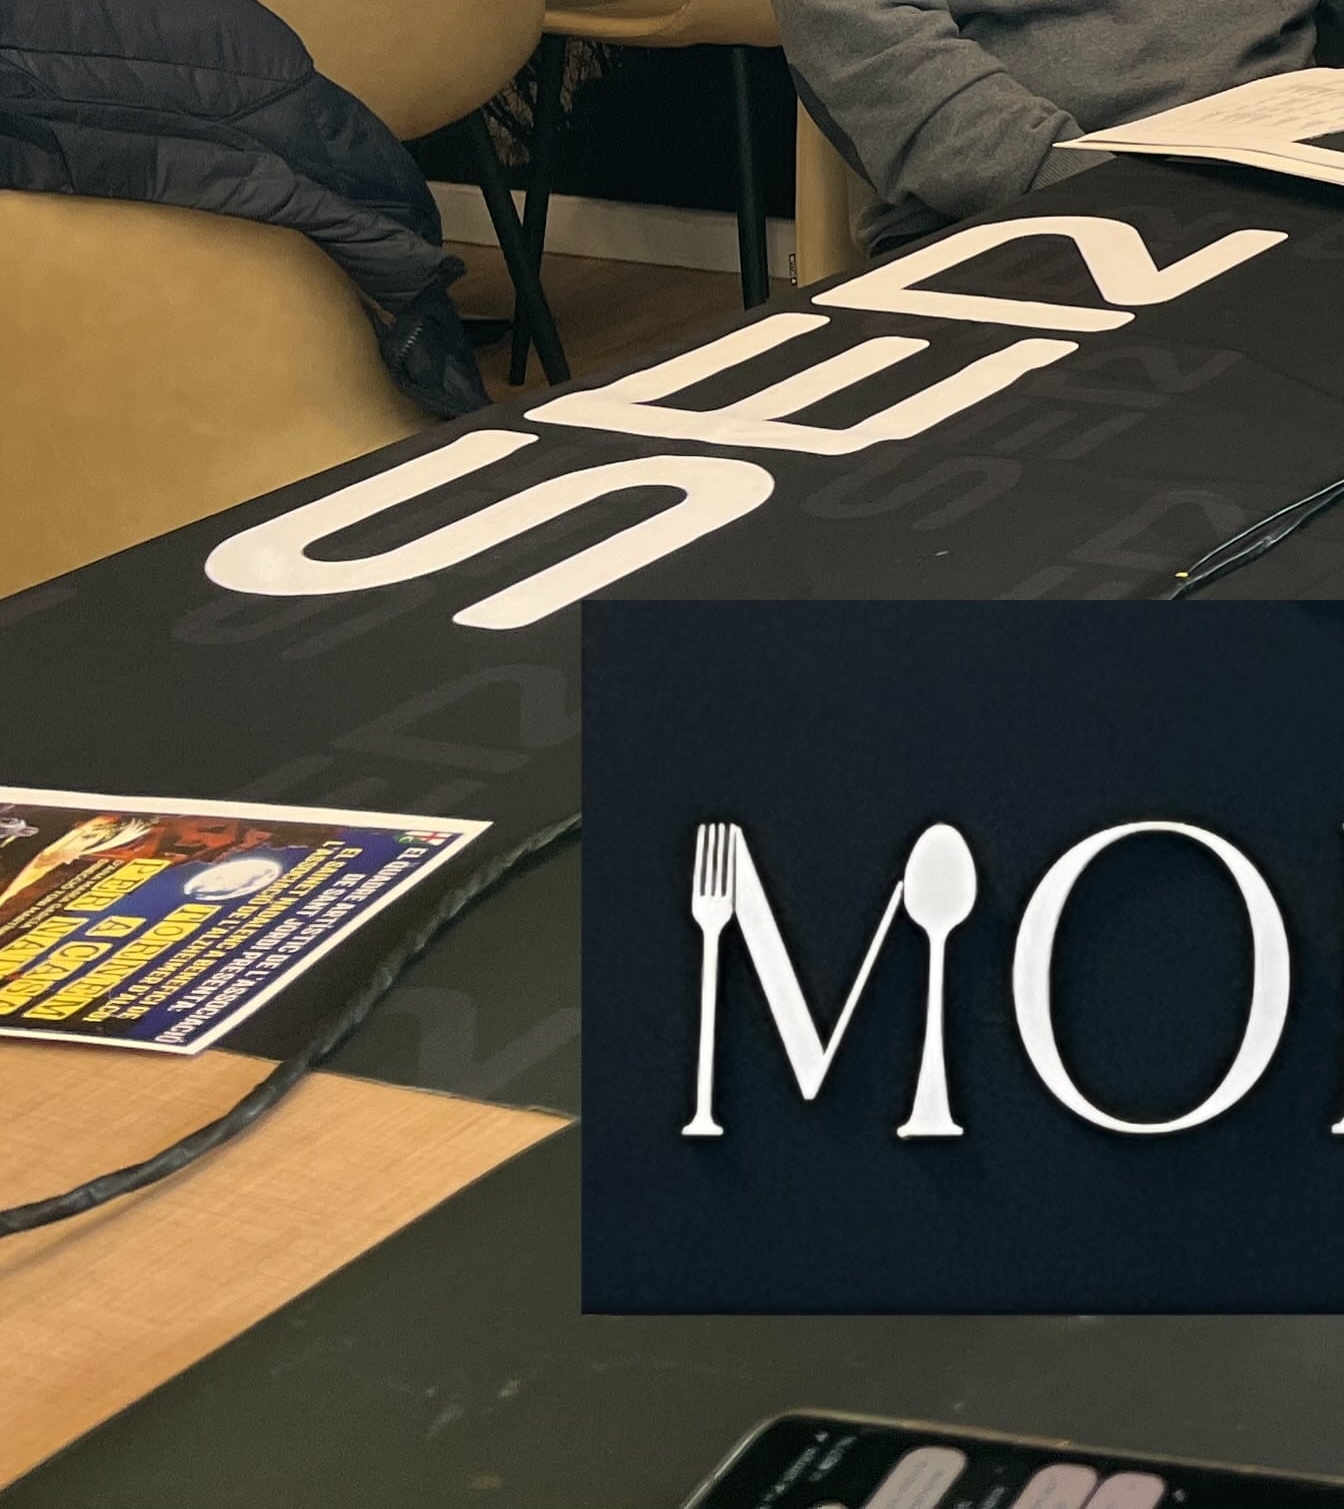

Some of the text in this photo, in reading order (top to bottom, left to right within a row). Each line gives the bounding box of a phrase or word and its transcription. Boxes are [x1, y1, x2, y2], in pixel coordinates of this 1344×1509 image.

[205, 216, 1288, 631] SER
[333, 847, 363, 859] EL
[396, 848, 428, 860] EL
[68, 861, 165, 910] PER
[332, 873, 366, 887] DE
[342, 861, 410, 901] QUADRE
[228, 905, 260, 919] DE
[296, 888, 346, 917] SANT
[250, 918, 303, 950] JORDI
[26, 906, 215, 1019] TORNEM
[256, 955, 290, 970] DE
[139, 960, 217, 1005] BENEFICI
